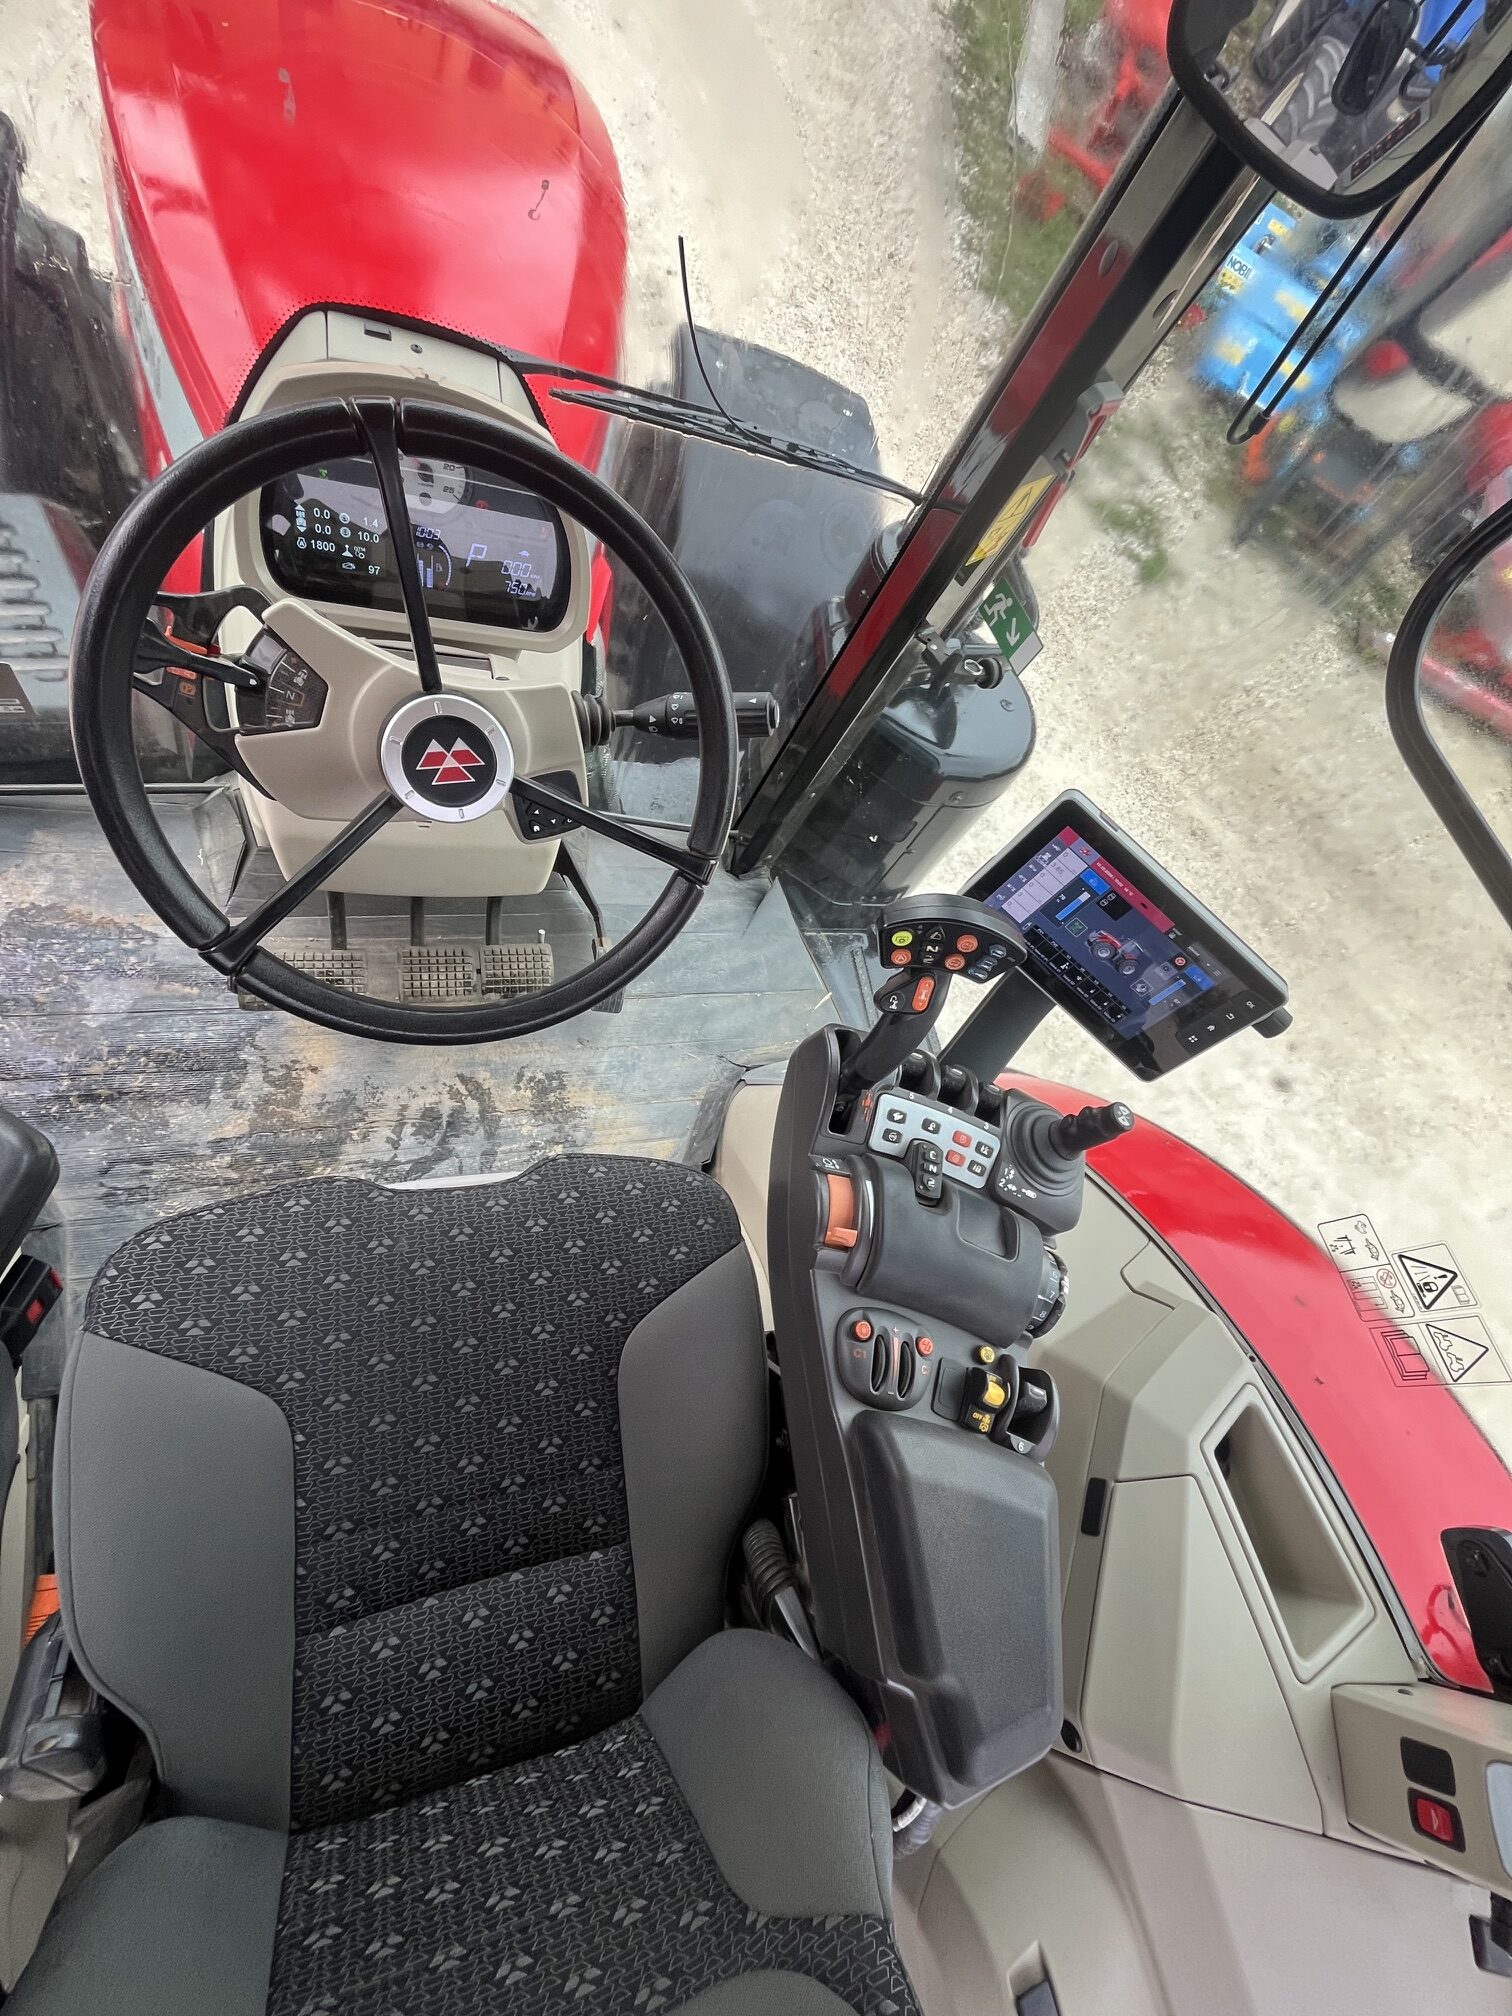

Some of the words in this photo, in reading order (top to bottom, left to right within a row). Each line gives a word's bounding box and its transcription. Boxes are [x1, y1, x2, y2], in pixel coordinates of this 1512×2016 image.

[443, 463, 455, 471] 20
[443, 485, 454, 494] 25
[313, 507, 331, 519] 0.0
[364, 516, 379, 528] 1.4
[314, 523, 332, 535] 0.0
[358, 531, 380, 543] 10.0
[310, 539, 336, 552] 1800
[465, 543, 488, 567] P
[368, 565, 381, 575] 97
[505, 580, 528, 596] 750
[286, 690, 296, 700] N
[909, 1092, 915, 1100] 5
[947, 1106, 953, 1114] 4
[983, 1121, 989, 1130] 3
[928, 1164, 938, 1174] N
[998, 1178, 1005, 1188] 2
[1049, 1290, 1055, 1299] 7
[1039, 1310, 1047, 1318] 8
